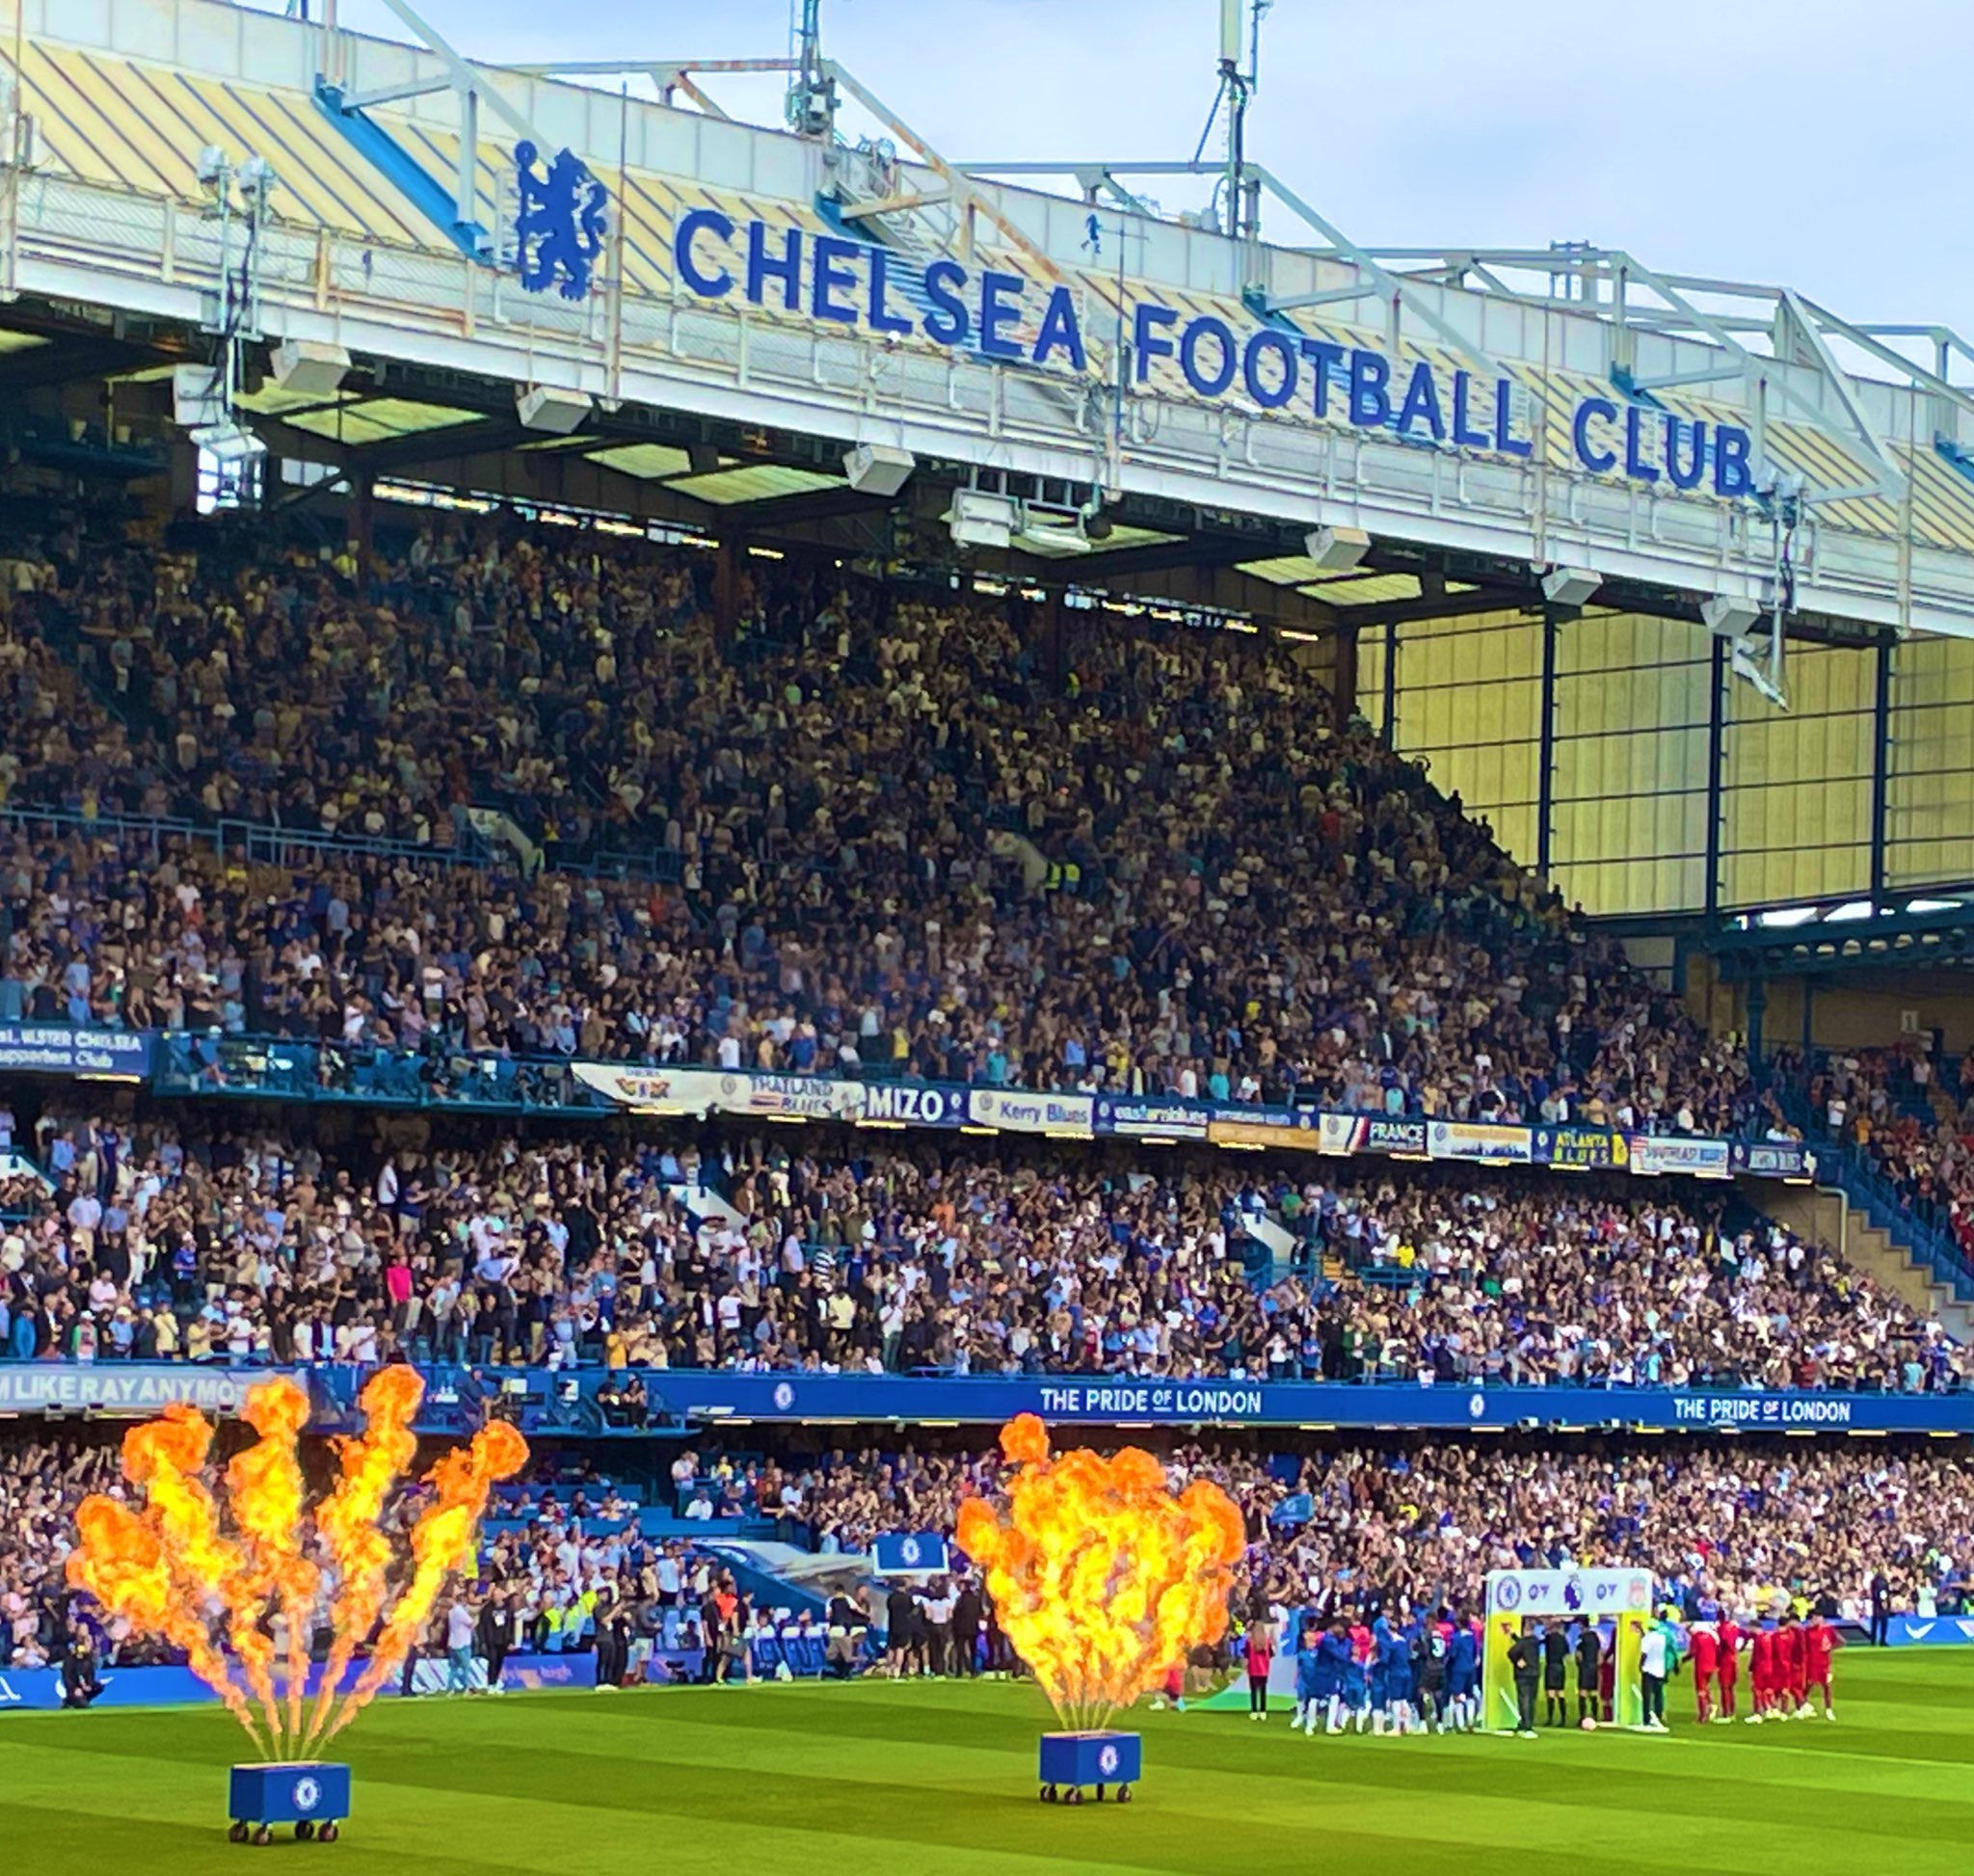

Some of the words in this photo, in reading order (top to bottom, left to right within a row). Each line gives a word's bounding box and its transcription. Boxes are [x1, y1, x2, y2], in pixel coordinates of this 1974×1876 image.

[675, 209, 1086, 370] CHELSEA
[1135, 302, 1533, 457] FOOTBALL
[1574, 396, 1755, 497] CLUB
[750, 1075, 834, 1096] THAILAND
[782, 1096, 833, 1113] BLUES
[867, 1086, 944, 1121] MIZO
[1000, 1100, 1041, 1124] Kerry
[1047, 1103, 1088, 1124] Blues
[1370, 1121, 1425, 1141] FRANCE
[1556, 1131, 1609, 1148] ATLANTA
[1554, 1147, 1609, 1165] BLUES
[14, 1376, 76, 1401] LIKE
[81, 1378, 135, 1402] RAY
[1040, 1388, 1080, 1411] THE
[1086, 1389, 1148, 1412] PRIDE
[1153, 1389, 1172, 1411] OF
[1177, 1390, 1262, 1414] LONDON
[1673, 1399, 1706, 1419] THE
[1710, 1400, 1760, 1422] PRIDE
[1763, 1401, 1778, 1420] OF
[1782, 1401, 1851, 1423] LONDON
